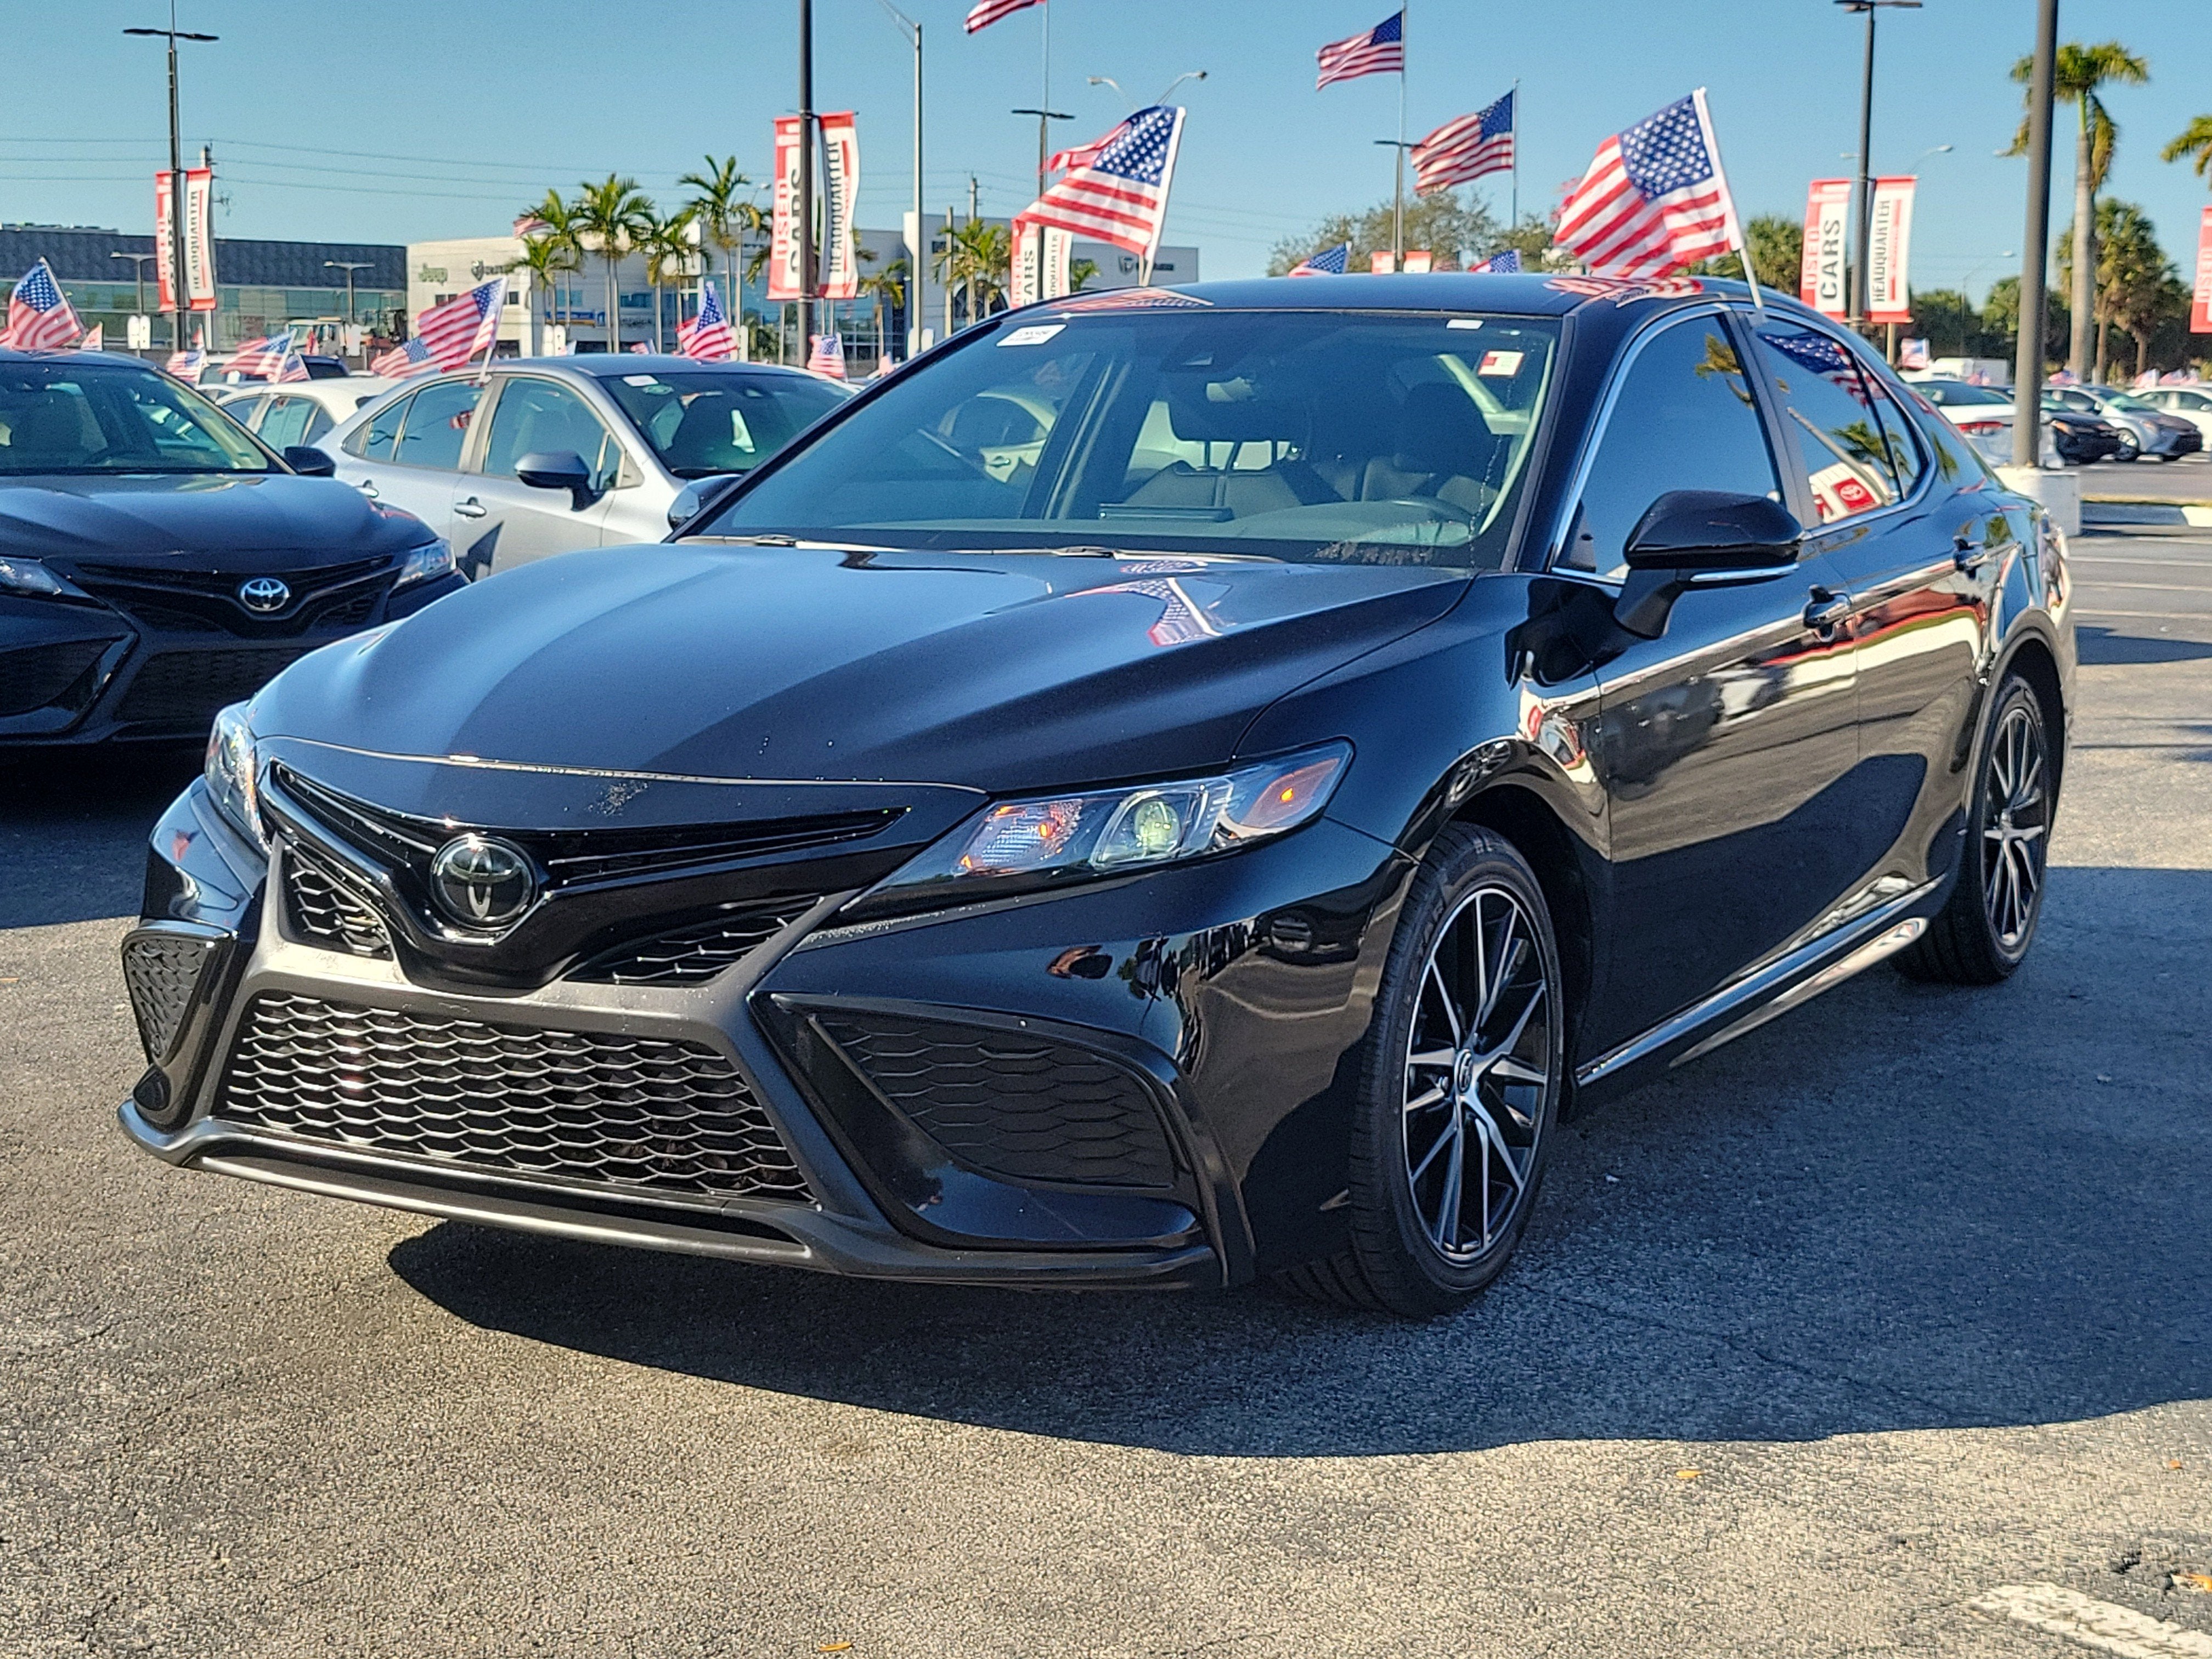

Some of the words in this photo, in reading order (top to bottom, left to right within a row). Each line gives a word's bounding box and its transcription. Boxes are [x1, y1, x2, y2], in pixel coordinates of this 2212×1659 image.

[190, 190, 200, 290] HEADQUARTER
[777, 182, 789, 256] USED
[826, 141, 844, 272] HEADQUARTER
[1872, 200, 1891, 302] HEADQUARTER
[1805, 230, 1819, 285] USED
[1820, 219, 1841, 301] CARS
